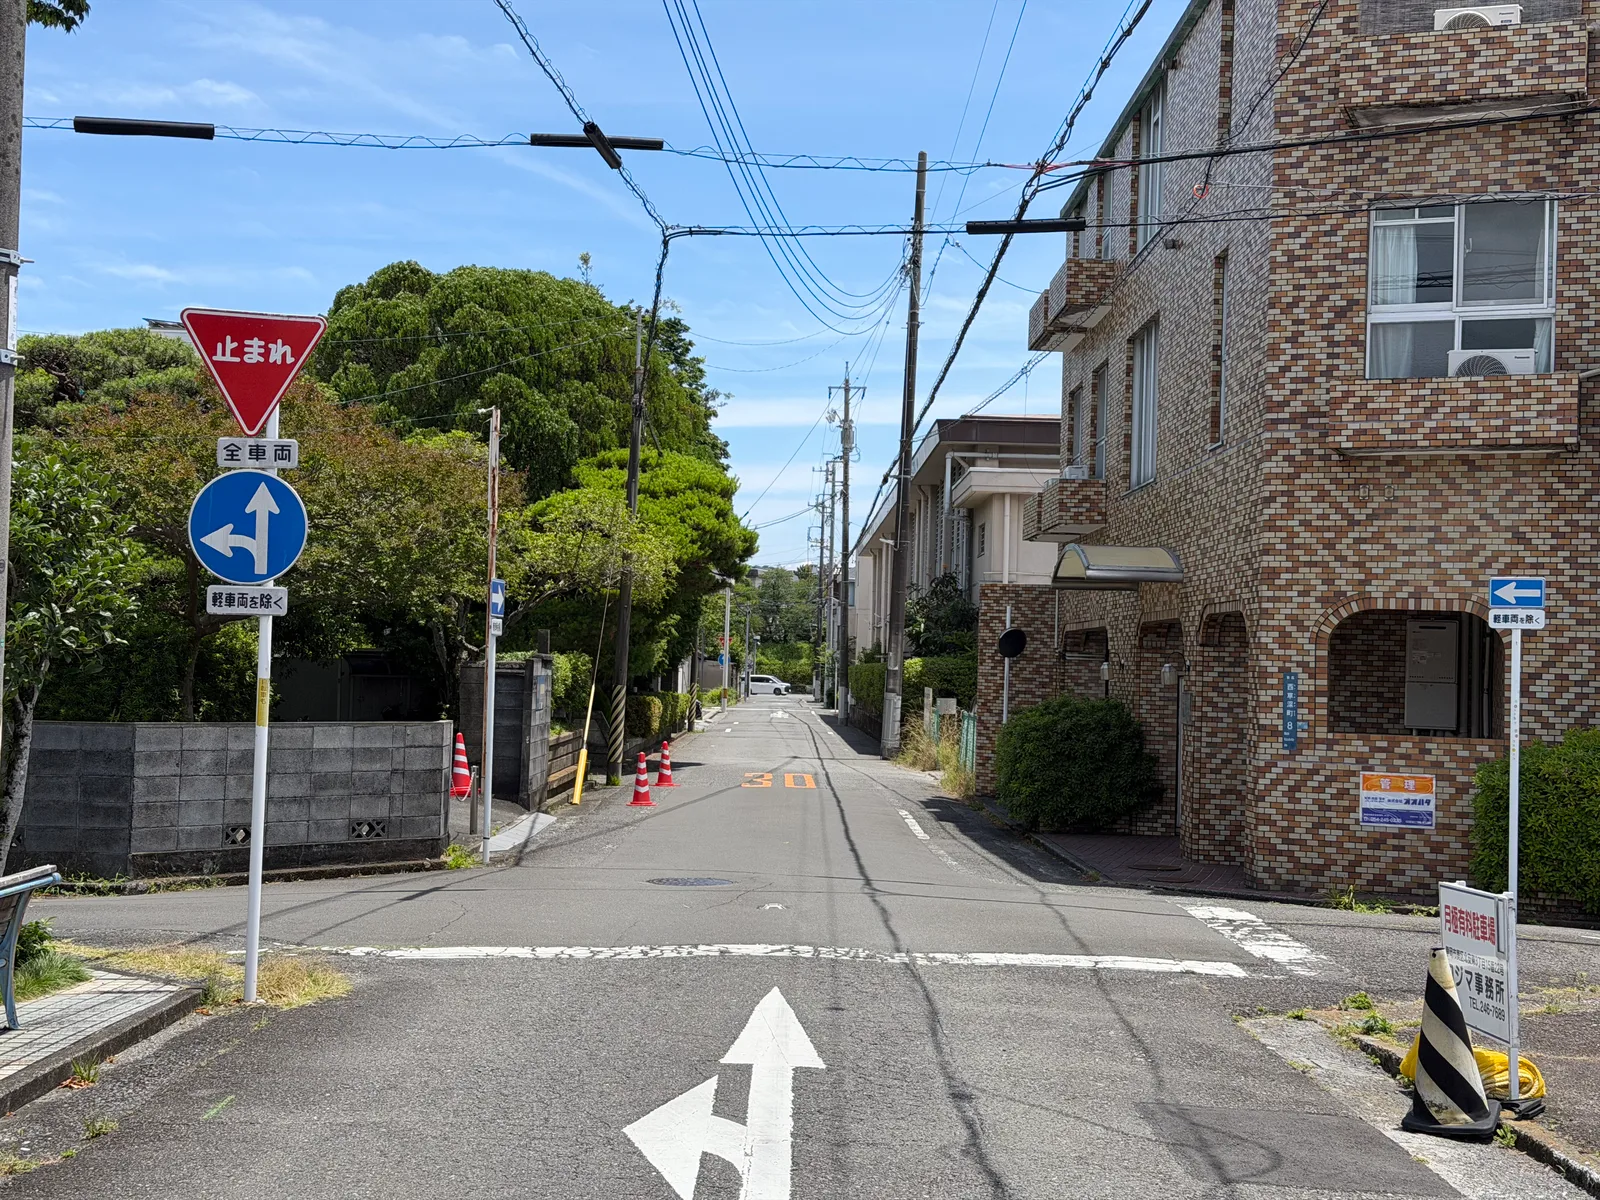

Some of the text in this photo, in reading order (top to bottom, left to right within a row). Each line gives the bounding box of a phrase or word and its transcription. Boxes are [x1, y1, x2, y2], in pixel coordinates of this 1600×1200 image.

[212, 334, 296, 365] 止まれ
[223, 442, 292, 463] 全車両
[211, 591, 283, 610] 軽車両を除く
[1493, 614, 1540, 625] 軽車両を除く
[1287, 721, 1293, 730] 8
[741, 772, 817, 789] 30
[1380, 778, 1416, 791] 管理
[1444, 904, 1496, 946] 月極有料駐車場
